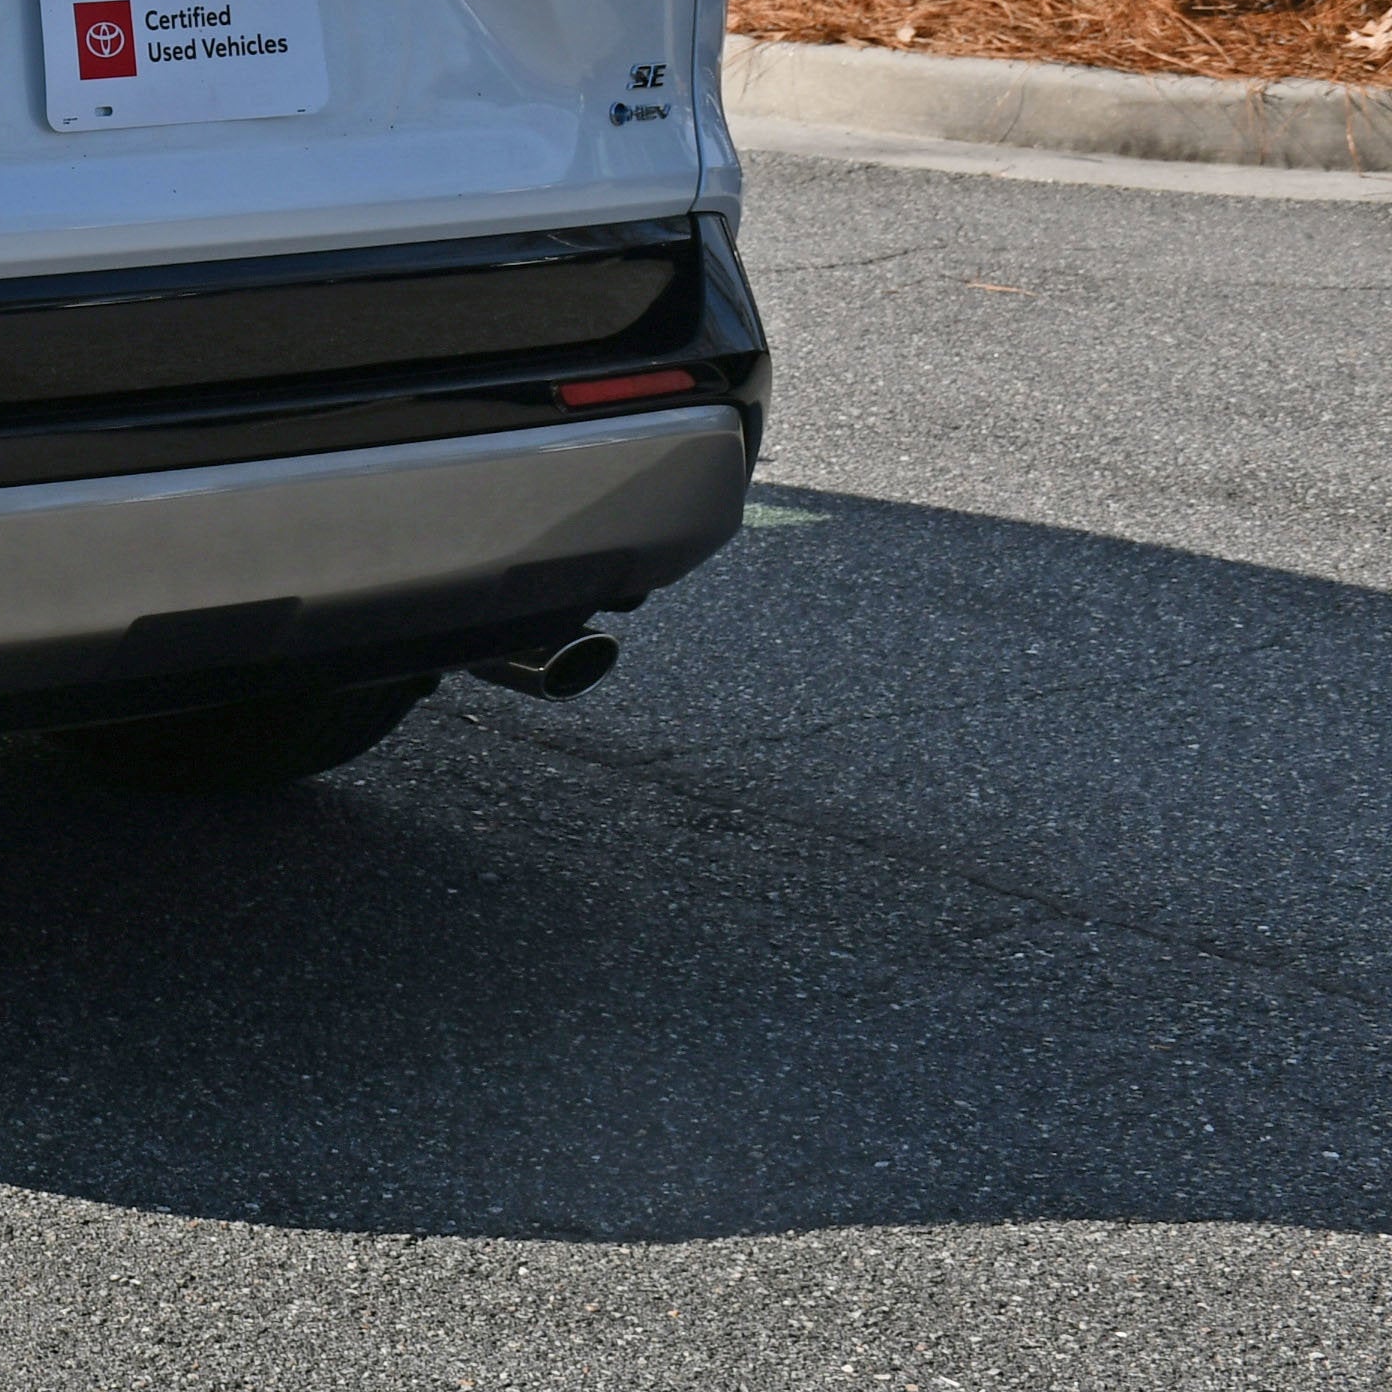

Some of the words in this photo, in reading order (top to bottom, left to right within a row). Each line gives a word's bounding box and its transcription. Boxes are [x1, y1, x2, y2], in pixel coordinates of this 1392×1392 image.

[145, 5, 231, 30] Certified
[148, 39, 196, 62] Used
[202, 33, 288, 58] Vehicles
[627, 63, 666, 90] SE
